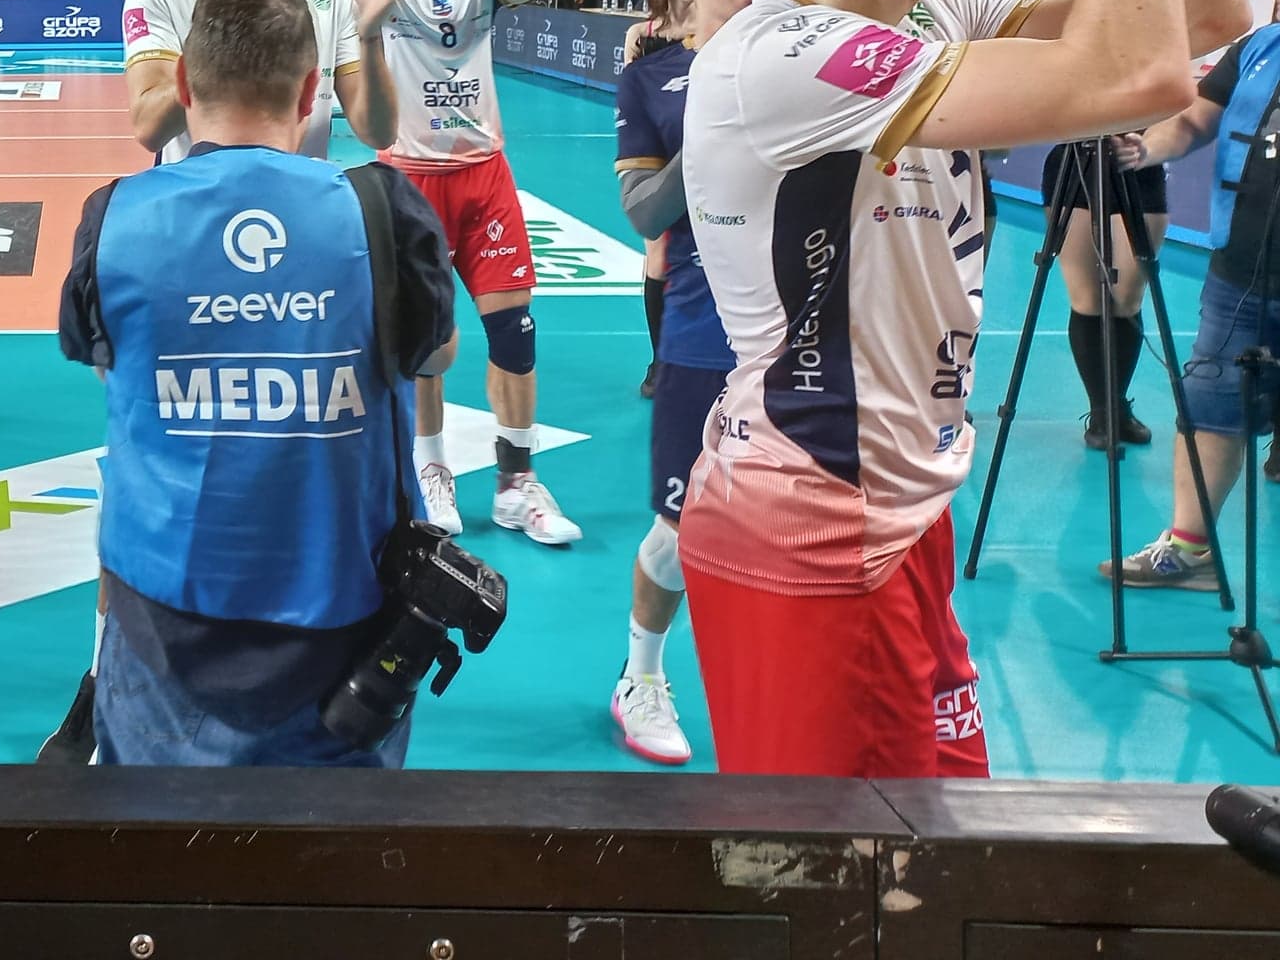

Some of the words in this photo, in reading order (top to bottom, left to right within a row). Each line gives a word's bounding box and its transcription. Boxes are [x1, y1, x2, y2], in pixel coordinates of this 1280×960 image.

[439, 22, 457, 49] 8
[480, 247, 498, 259] Vip
[498, 246, 518, 257] Car
[187, 290, 335, 325] zeever
[155, 365, 366, 423] MEDIA
